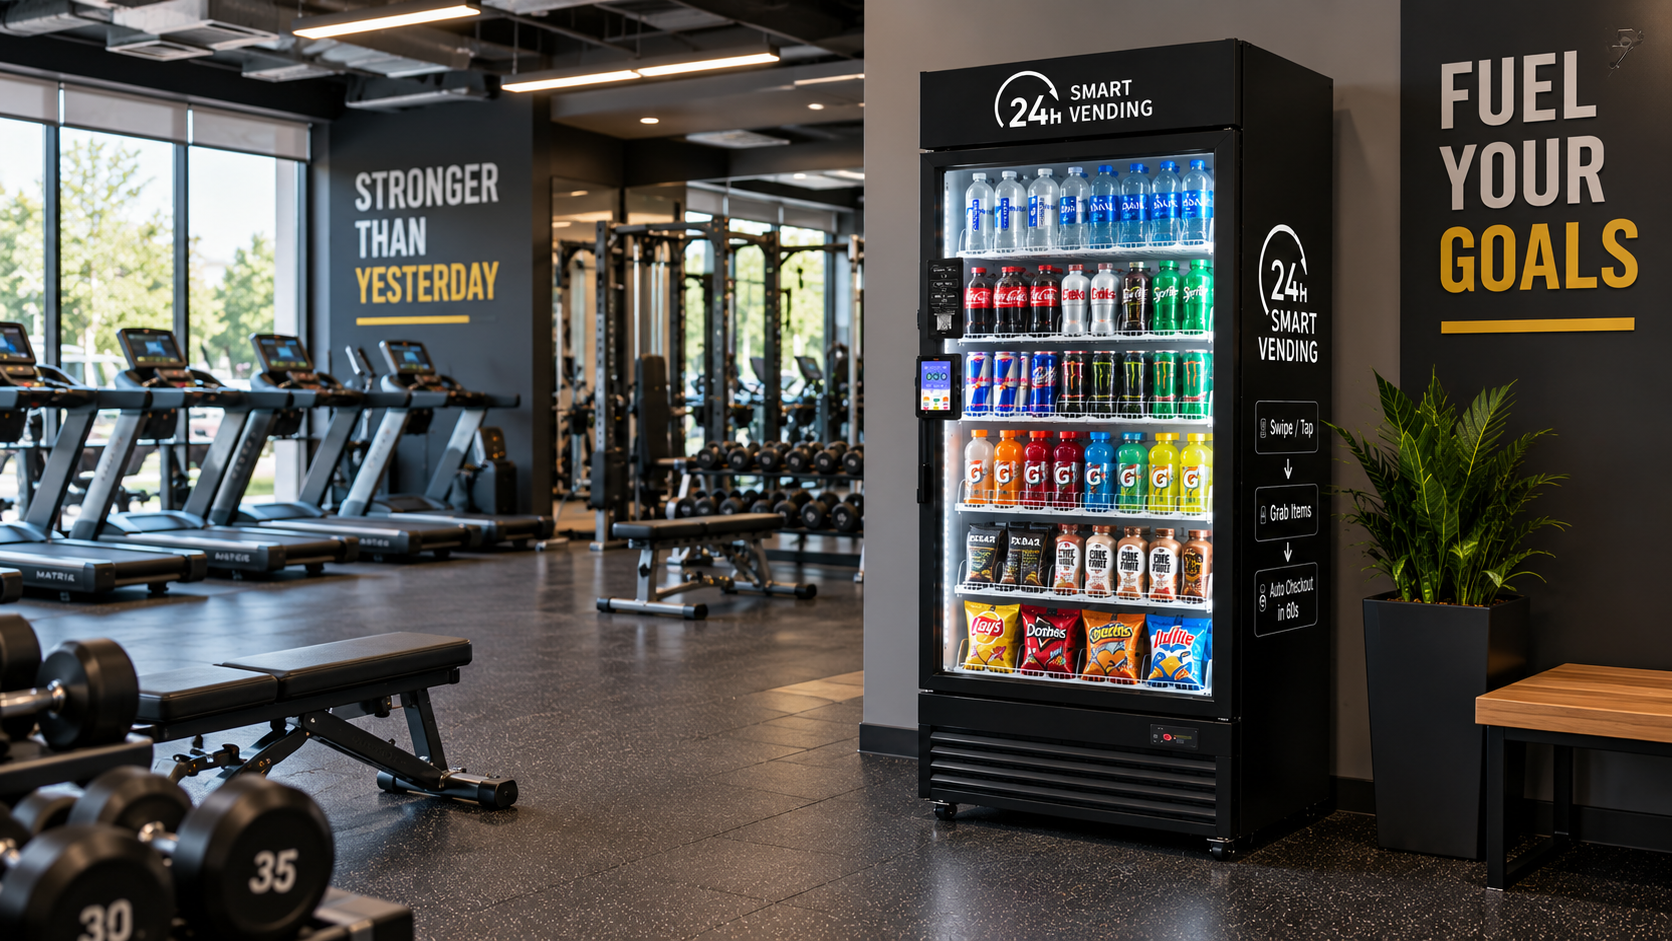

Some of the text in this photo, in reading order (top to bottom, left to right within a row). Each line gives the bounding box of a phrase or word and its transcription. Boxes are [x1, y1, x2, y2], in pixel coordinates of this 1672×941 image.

[1070, 79, 1132, 101] SMART
[1441, 50, 1597, 129] FUEL
[1069, 99, 1153, 123] VENDING
[1439, 135, 1606, 211] YOUR
[355, 162, 499, 212] STRONGER
[354, 216, 427, 259] THAN
[1440, 218, 1639, 294] GOALS
[355, 261, 499, 304] YESTERDAY
[1271, 309, 1317, 334] SMART
[1258, 336, 1318, 363] VENDING
[1270, 419, 1293, 439] Swipe
[1300, 419, 1314, 439] Tap
[968, 464, 981, 483] G
[995, 464, 1010, 484] G
[1025, 465, 1040, 485] G
[1055, 465, 1070, 485] G
[1086, 466, 1101, 486] G
[1120, 467, 1136, 487] G
[1152, 468, 1168, 488] G
[1183, 469, 1199, 489] G
[1270, 503, 1312, 521] Grab Items
[1269, 581, 1284, 598] Auto
[1277, 601, 1299, 621] in 60s
[248, 848, 299, 894] 35
[77, 899, 133, 941] 30
